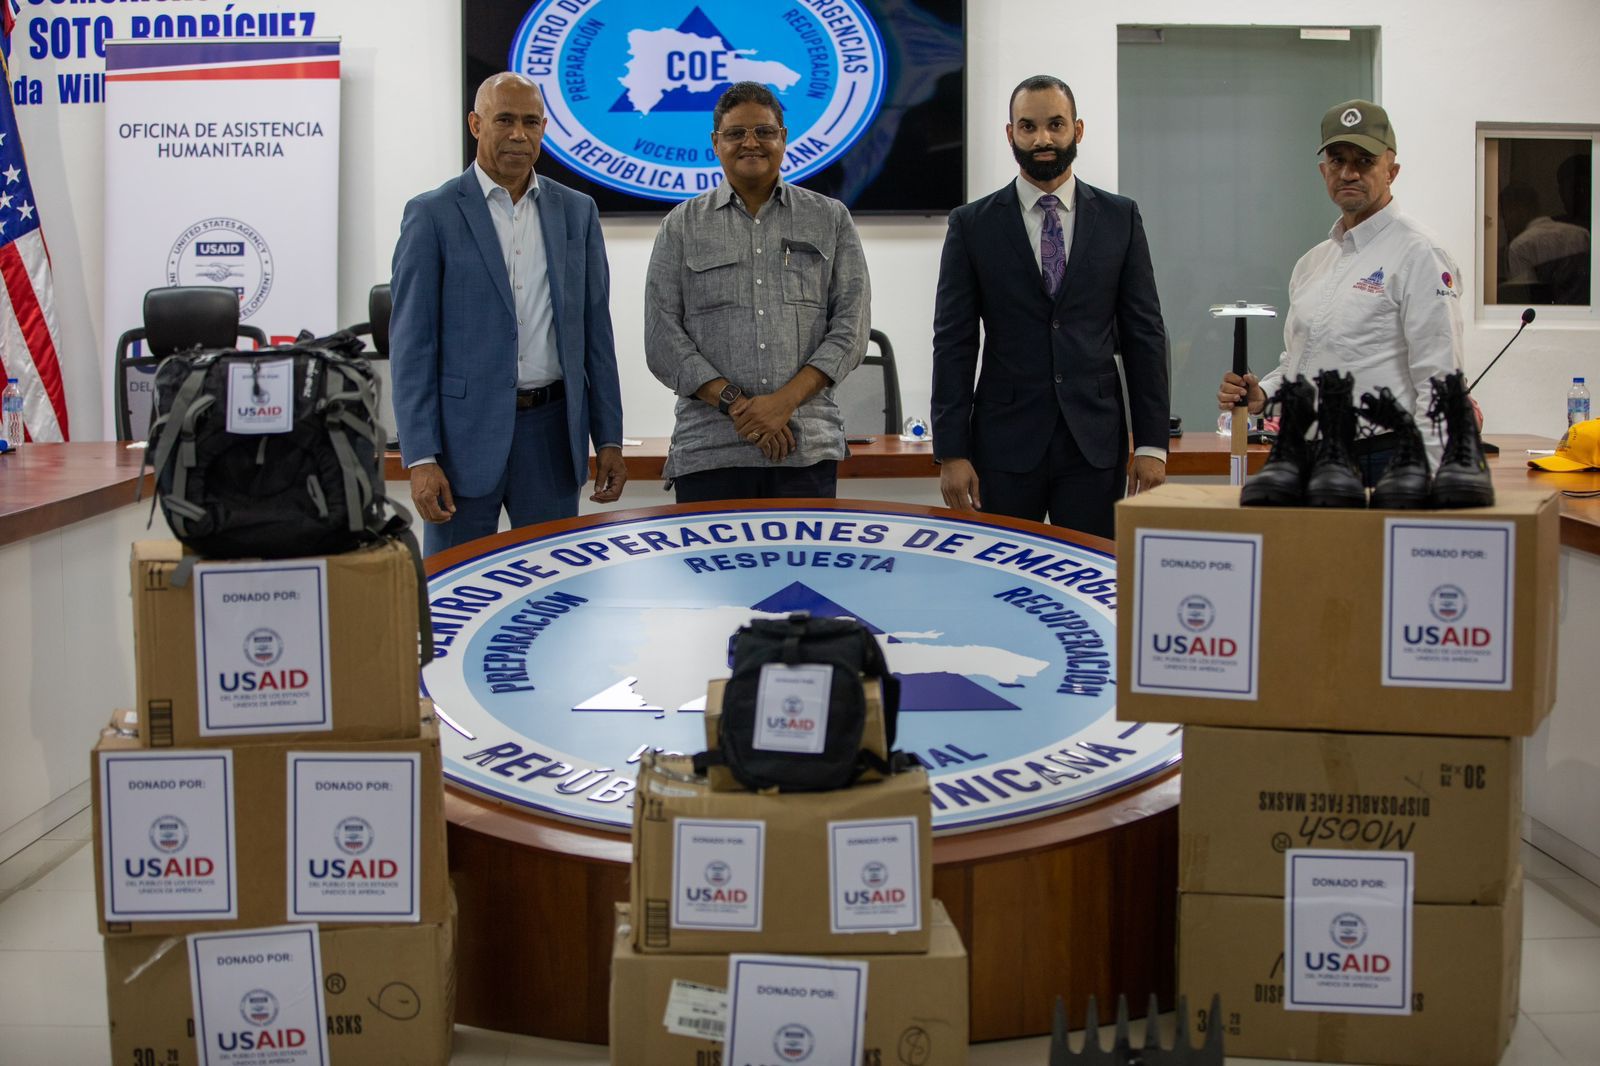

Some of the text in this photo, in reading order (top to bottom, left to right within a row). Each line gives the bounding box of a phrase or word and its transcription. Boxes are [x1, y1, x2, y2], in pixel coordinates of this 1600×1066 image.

[527, 0, 590, 76] CENTRO D
[804, 0, 868, 74] RGENCIAS
[565, 18, 606, 103] PREPARACIÓN
[781, 8, 832, 100] RECUPERACIÓN
[667, 50, 728, 82] COE
[119, 121, 324, 139] OFICINA DE ASISTENCIA
[158, 142, 284, 158] HUMANITARIA
[633, 137, 697, 162] VOCERO
[569, 138, 686, 191] REPÚBLICA
[174, 220, 267, 254] UNITED STATES AGENCY
[200, 244, 240, 254] USAID
[237, 406, 282, 417] USAID
[481, 559, 560, 588] DE
[550, 521, 890, 569] OPERACIONES
[902, 528, 974, 554] DE
[684, 551, 896, 574] RESPUESTA
[1411, 548, 1458, 559] DONADO
[1161, 559, 1206, 570] DONADO
[222, 592, 271, 603] DONADO
[483, 591, 589, 694] PREPARACIÓN
[993, 586, 1117, 697] RECUPERACIÓN
[1153, 634, 1237, 657] USAID
[1404, 625, 1491, 647] USAID
[219, 669, 309, 692] USAID
[767, 717, 815, 731] USAID
[128, 781, 176, 791] DONADO
[315, 782, 363, 792] DONADO
[1258, 791, 1430, 817] DISPOSABLE FACE MASKS
[125, 857, 214, 878] USAID
[309, 858, 398, 879] USAID
[1312, 877, 1358, 888] DONADO
[686, 887, 748, 904] USAID
[844, 889, 906, 905] USAID
[217, 955, 264, 966] DONADO
[1305, 952, 1391, 973] USAID
[757, 985, 807, 998] DONADO
[326, 1014, 362, 1035] ASKS
[218, 1028, 306, 1051] USAID
